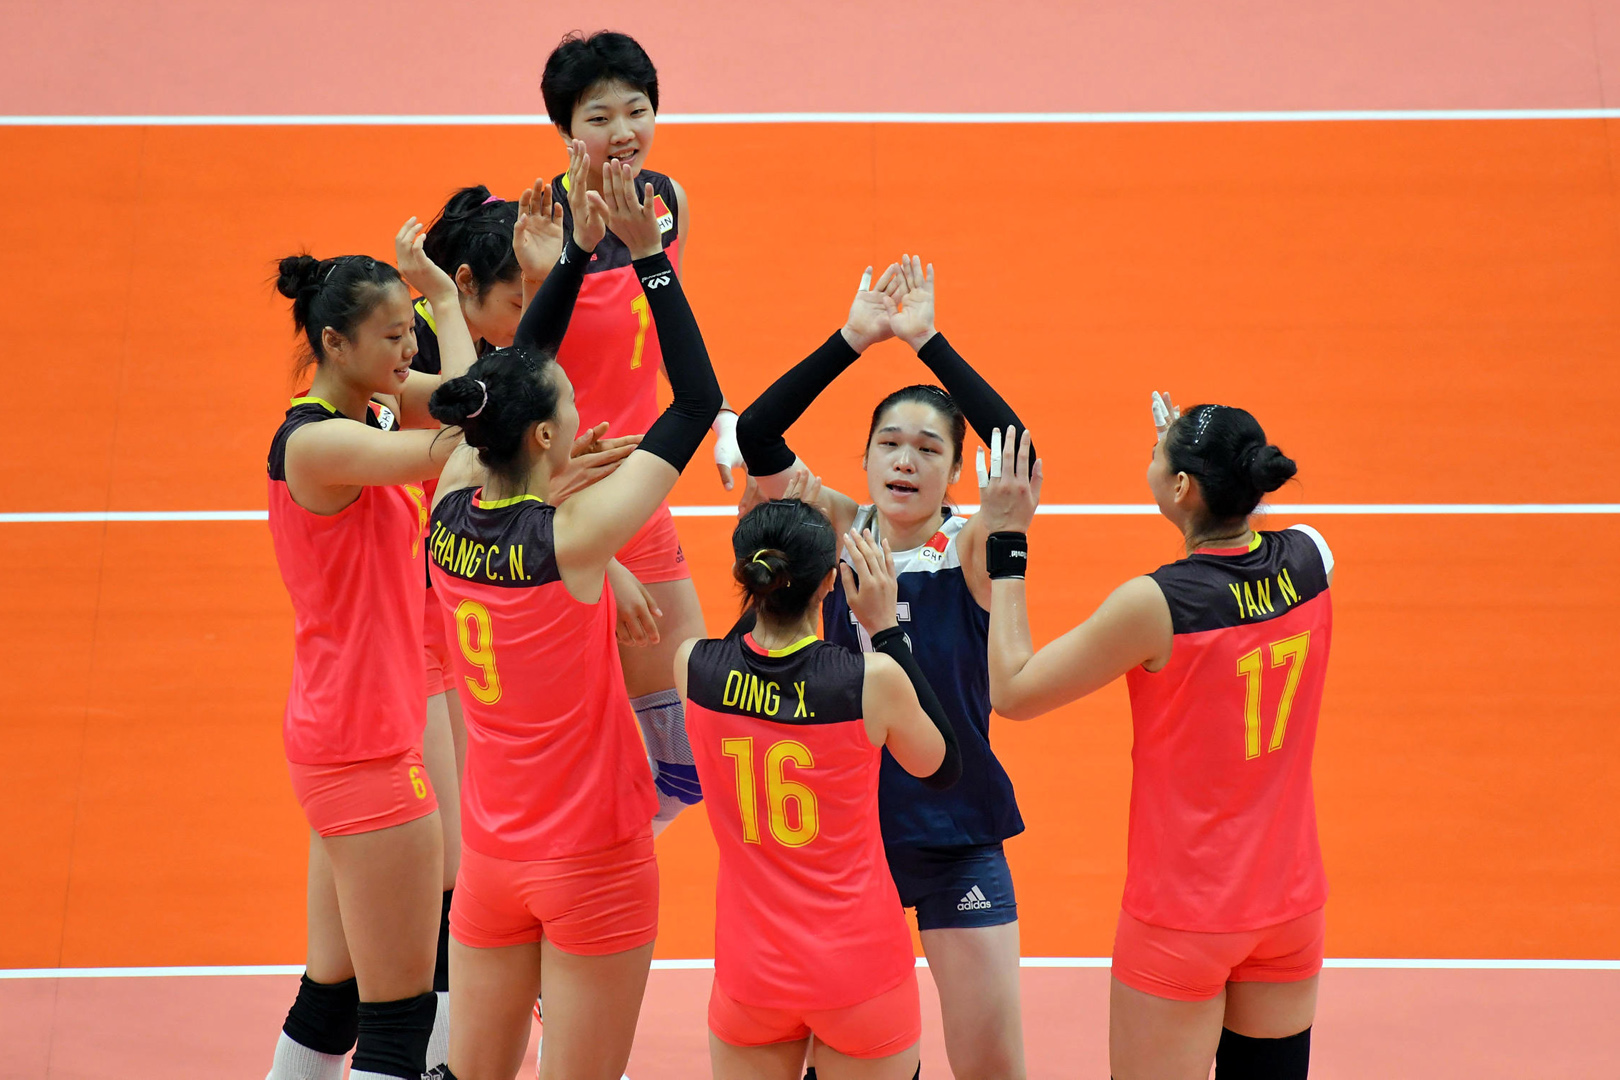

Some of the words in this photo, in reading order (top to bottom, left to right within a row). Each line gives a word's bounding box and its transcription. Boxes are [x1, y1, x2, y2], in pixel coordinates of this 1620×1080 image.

[658, 217, 672, 230] HN
[379, 410, 391, 429] CHN
[430, 520, 485, 578] ZHANG
[485, 545, 504, 581] C.
[509, 544, 532, 581] N.
[1229, 577, 1275, 619] YAN
[1277, 568, 1302, 607] N.
[454, 599, 503, 706] 9
[722, 670, 780, 717] DING
[794, 681, 815, 718] X.
[1236, 629, 1311, 761] 17
[409, 766, 427, 800] 6
[721, 736, 819, 848] 16
[957, 901, 992, 911] adidas
